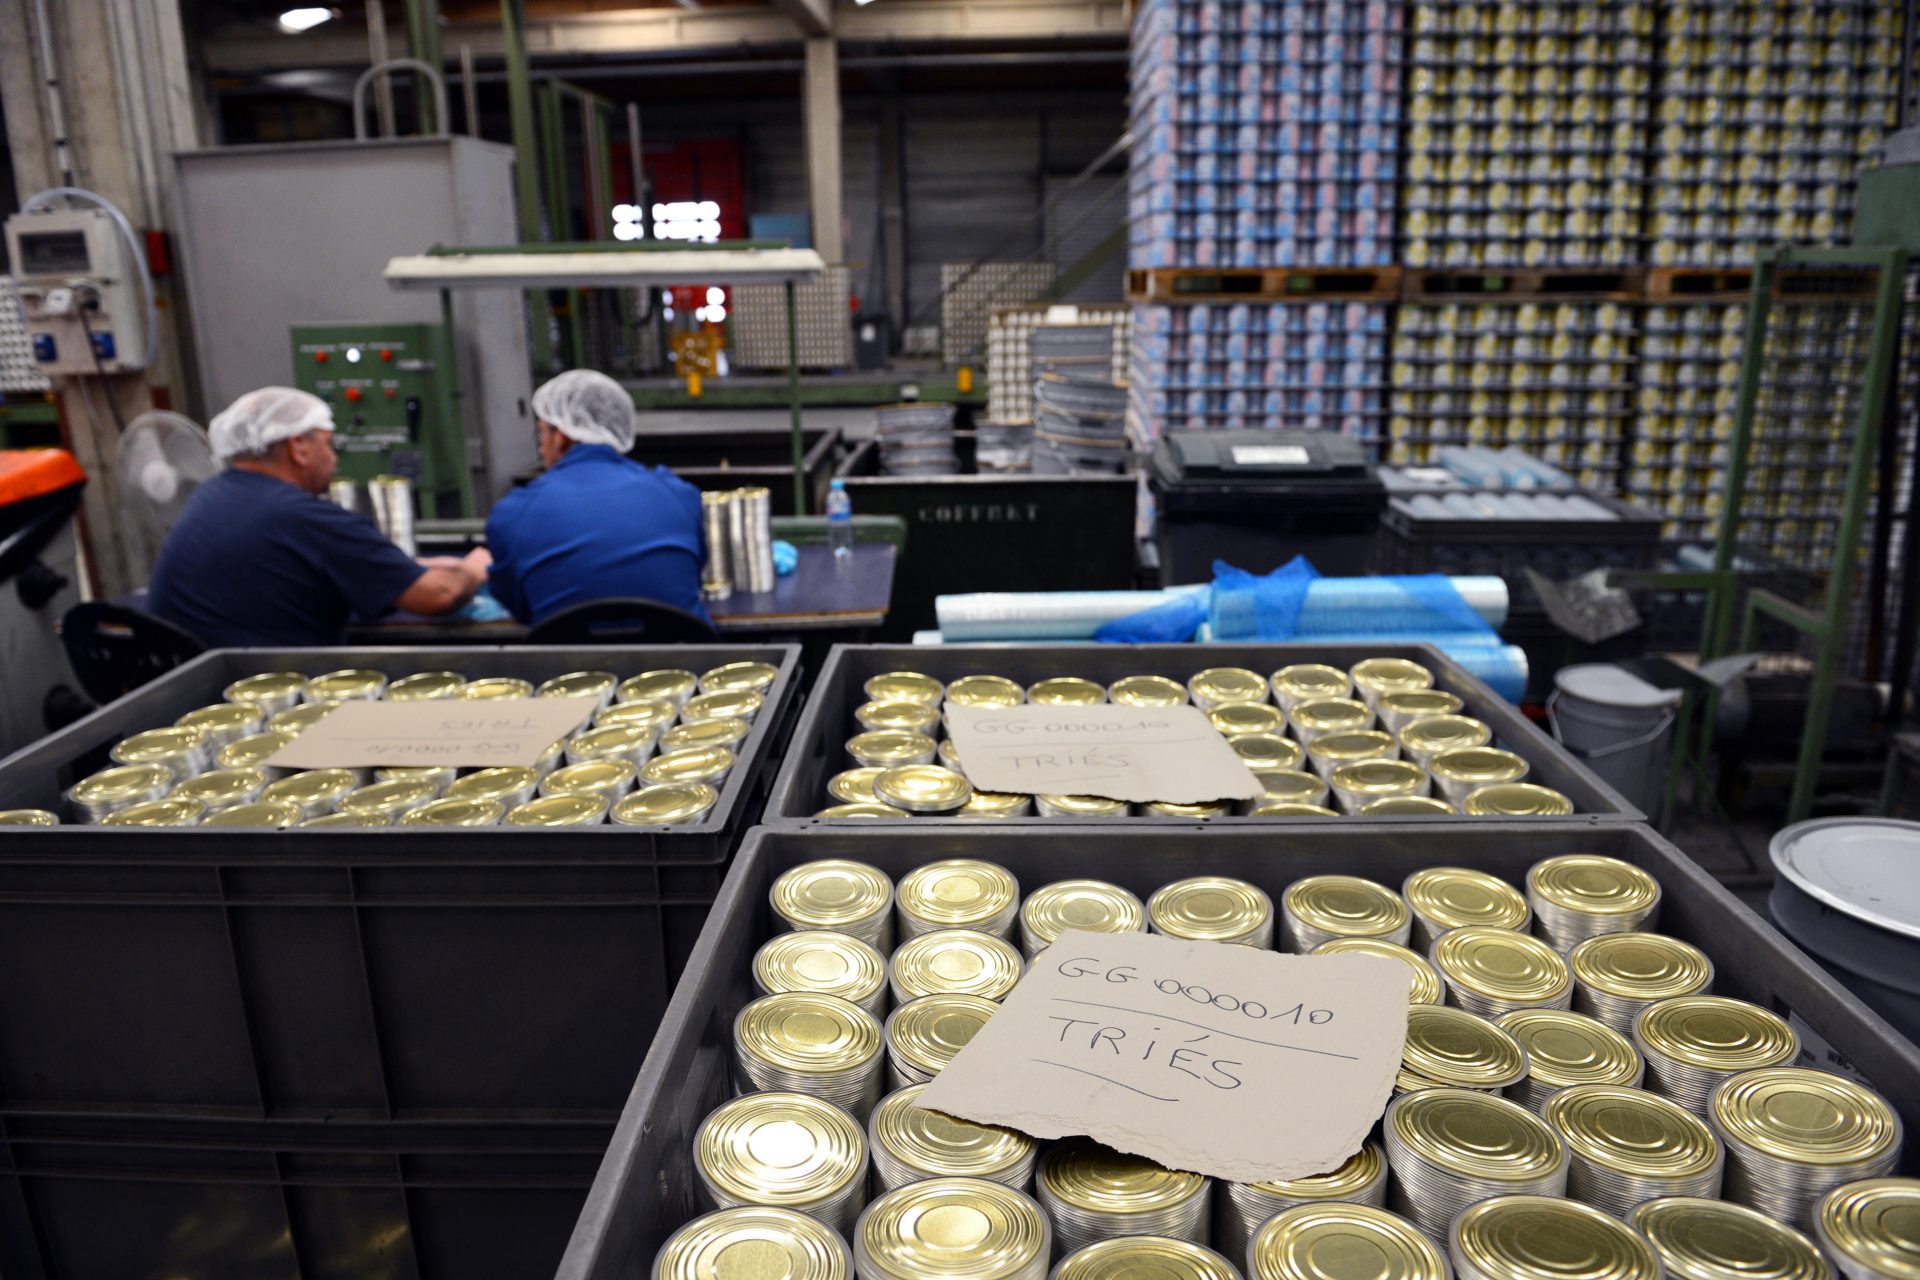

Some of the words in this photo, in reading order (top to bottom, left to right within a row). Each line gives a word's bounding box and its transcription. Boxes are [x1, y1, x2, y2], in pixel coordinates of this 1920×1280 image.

[973, 720, 1037, 734] GG
[1058, 958, 1138, 984] GG
[1154, 979, 1335, 1026] 000010
